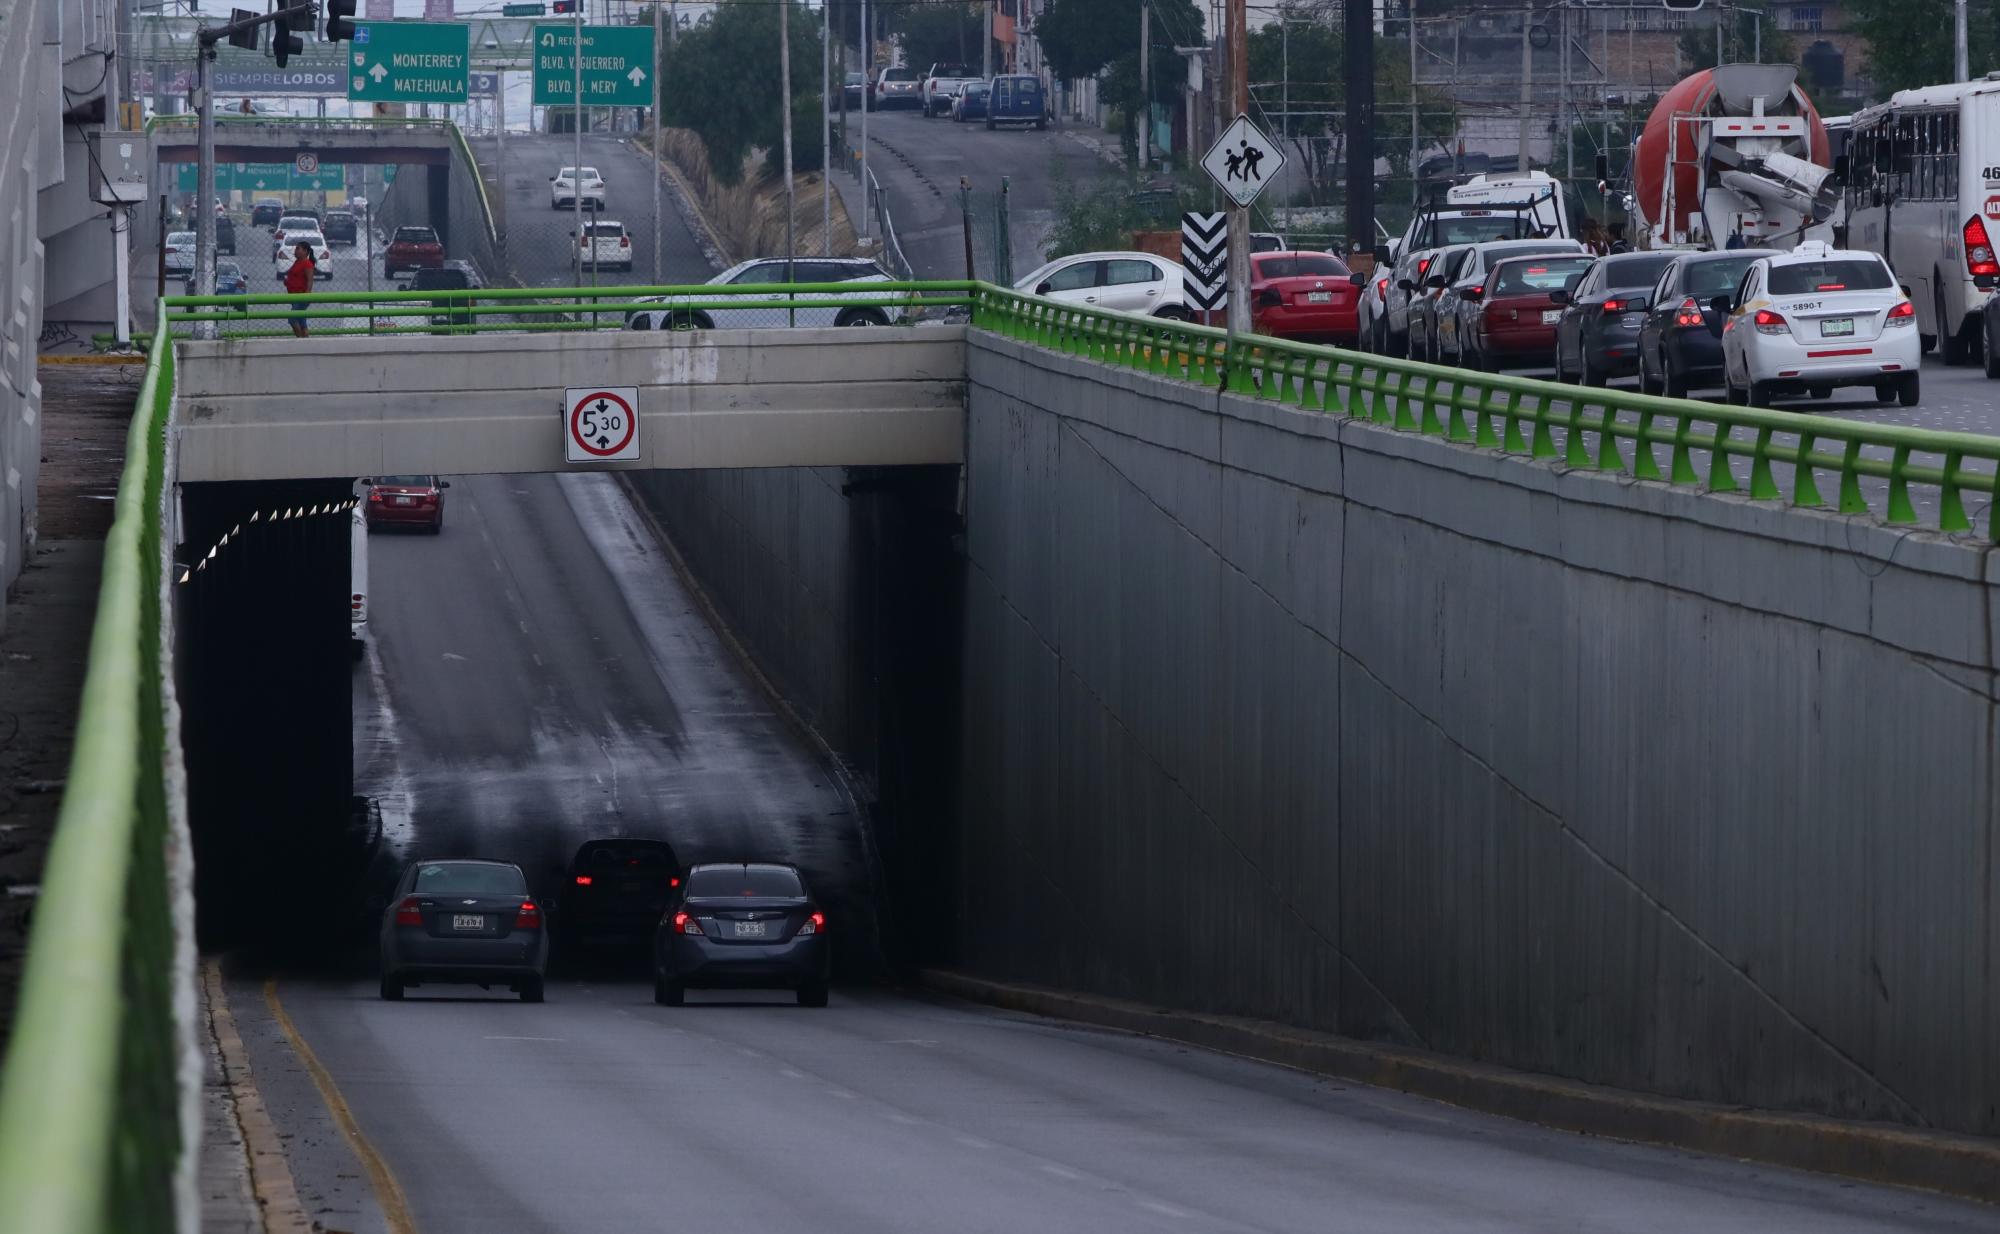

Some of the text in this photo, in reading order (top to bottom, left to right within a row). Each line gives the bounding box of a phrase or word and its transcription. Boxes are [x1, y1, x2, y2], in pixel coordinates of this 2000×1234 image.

[393, 53, 462, 68] MONTERREY
[541, 55, 565, 69] BLVD.
[580, 56, 625, 70] GUERRERO
[394, 78, 464, 93] MATEHUALA
[548, 80, 573, 93] BLVD.
[591, 80, 617, 94] MERY
[1793, 302, 1823, 311] 5890-T
